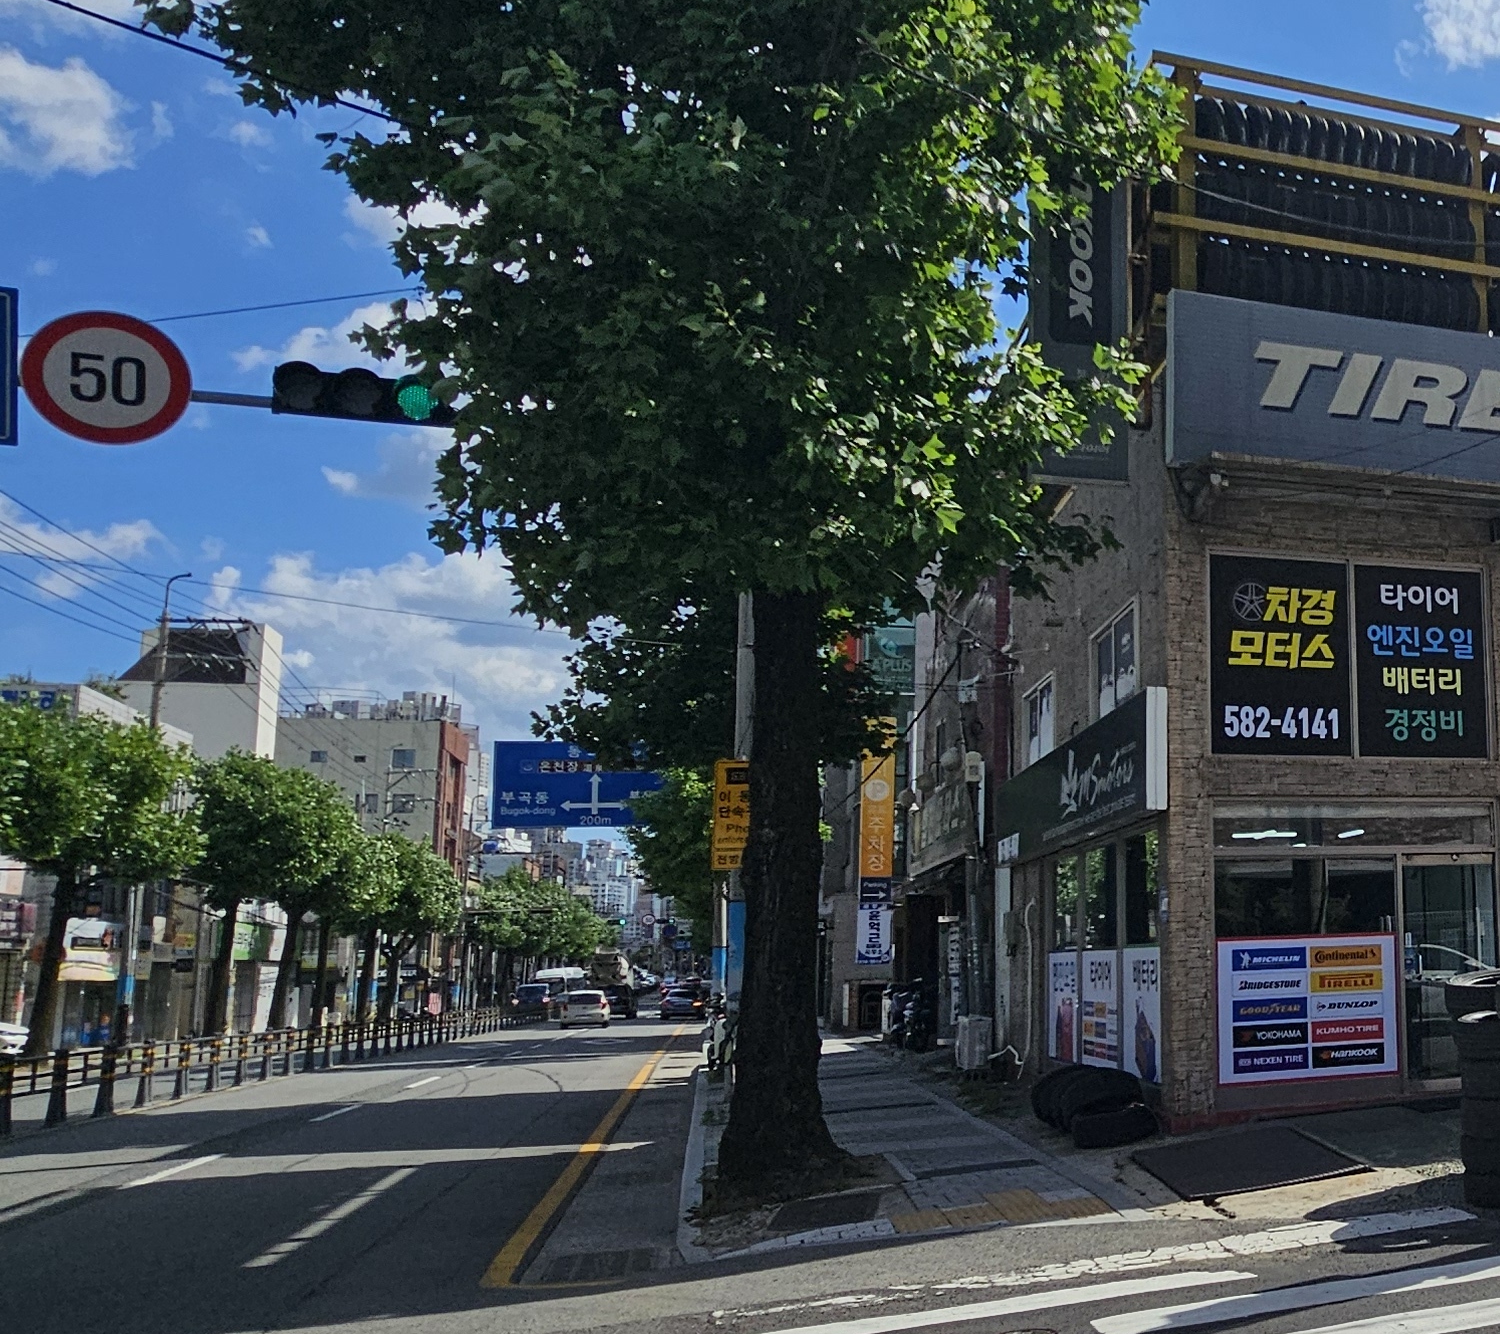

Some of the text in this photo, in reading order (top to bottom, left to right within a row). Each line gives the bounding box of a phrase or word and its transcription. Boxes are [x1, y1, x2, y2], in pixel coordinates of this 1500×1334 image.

[69, 351, 147, 407] 50
[1380, 583, 1460, 614] 타이어
[1263, 586, 1336, 626] 차경
[1366, 624, 1475, 660] 엔진오일
[1228, 630, 1335, 669] 모터스
[1382, 666, 1462, 695] 배터리
[1224, 705, 1339, 739] 582-4141
[1384, 708, 1464, 742] 경정비
[501, 791, 549, 805] 부곡동
[501, 807, 556, 816] Bugok-dong
[718, 806, 750, 819] 단속
[580, 815, 612, 826] 200m
[1252, 955, 1301, 964] MICHELIN
[1314, 949, 1368, 964] Continental
[1238, 979, 1301, 991] BRIDGESTONE
[1319, 972, 1374, 989] PIRELLI
[1327, 1000, 1378, 1010] DUNLOP
[1256, 1029, 1302, 1040] YOKOHAMA
[1316, 1024, 1379, 1035] KUMHO TIRE
[1253, 1056, 1283, 1066] NEXEN
[1285, 1054, 1304, 1063] TIRE
